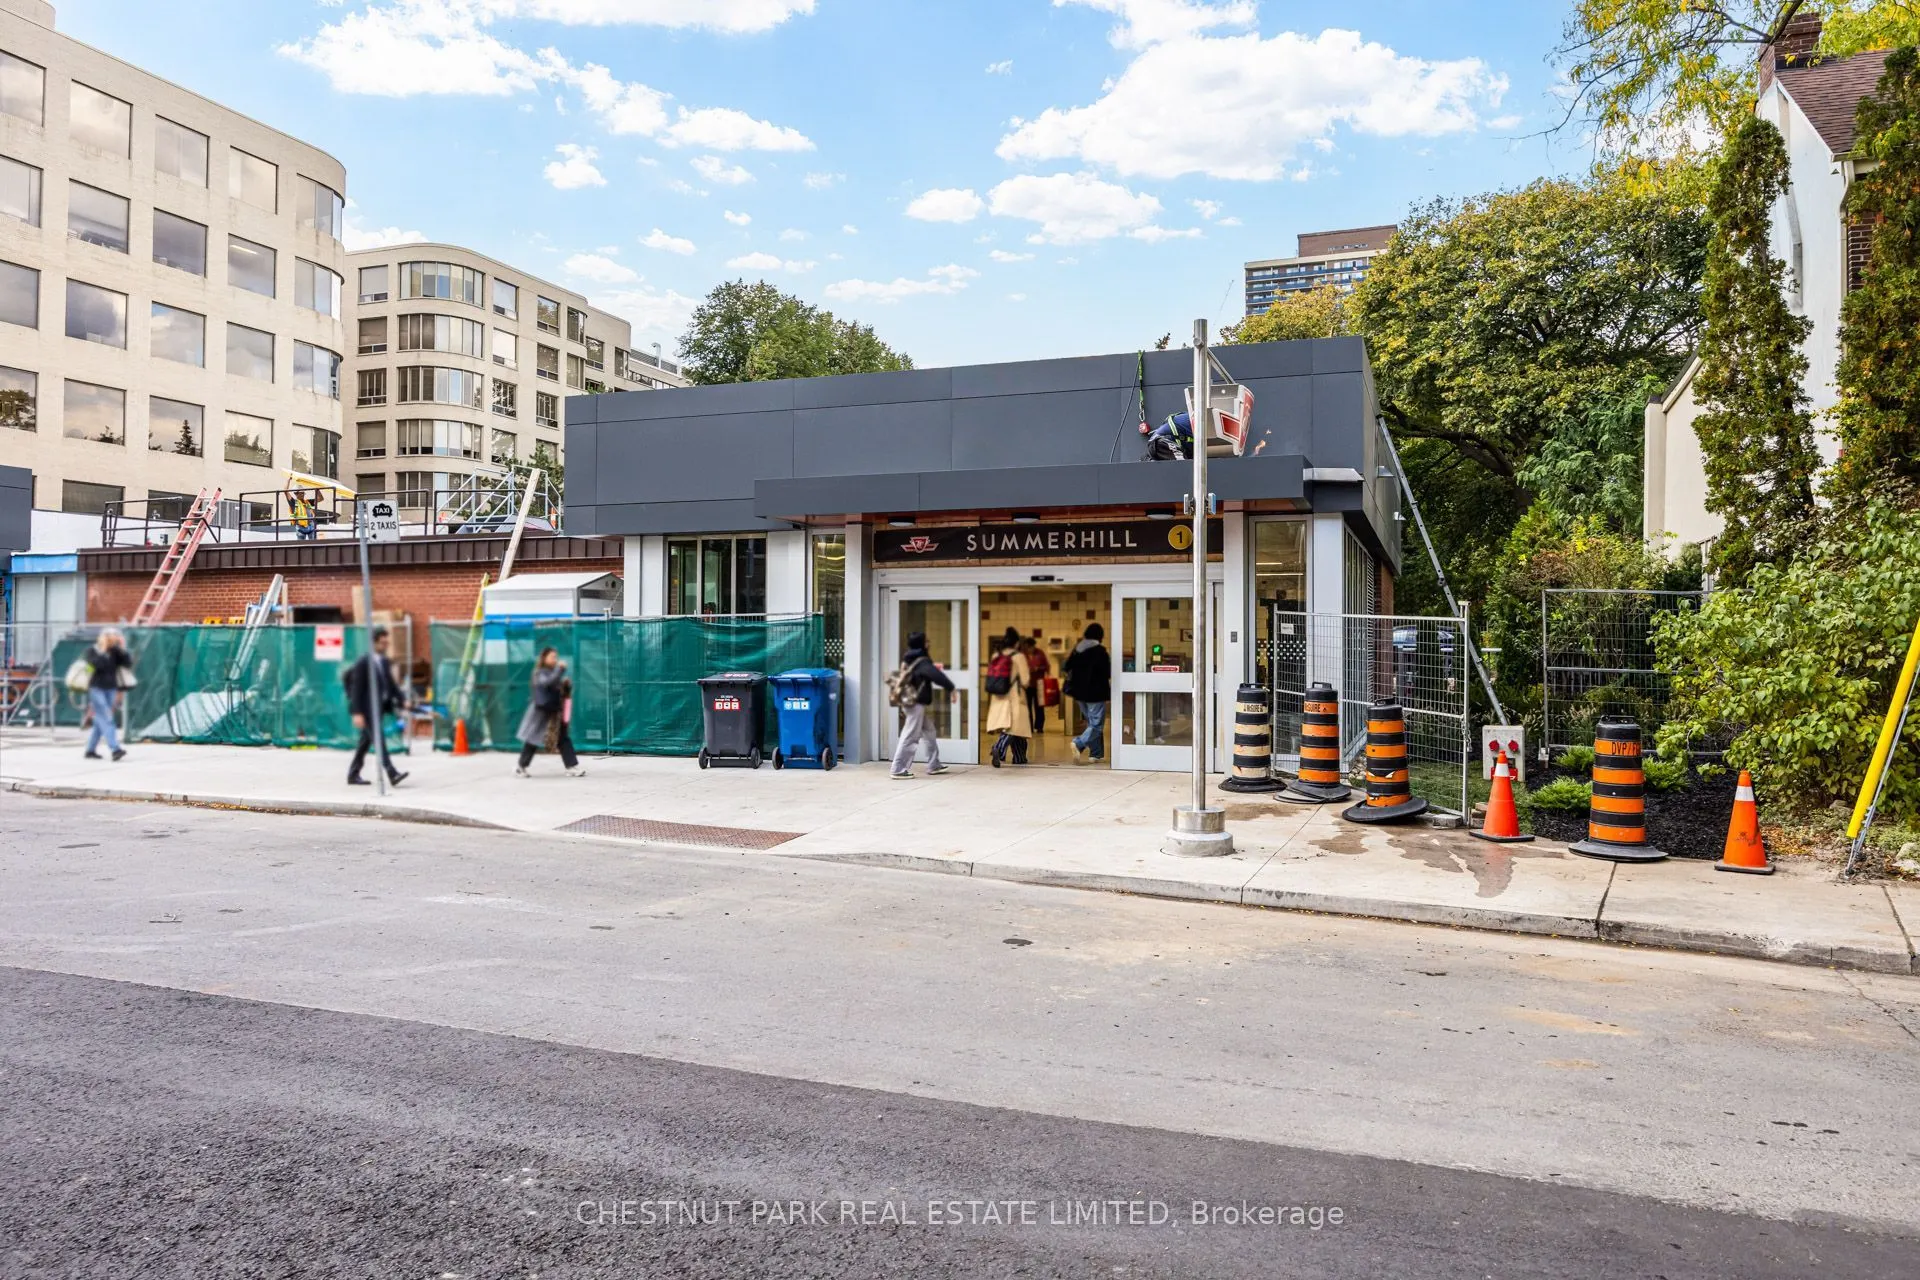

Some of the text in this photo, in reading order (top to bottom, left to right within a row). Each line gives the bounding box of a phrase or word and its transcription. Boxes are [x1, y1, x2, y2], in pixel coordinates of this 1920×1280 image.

[370, 521, 397, 530] 2 TAXIS
[966, 529, 1137, 552] SUMMERHILL
[1176, 531, 1183, 544] 1
